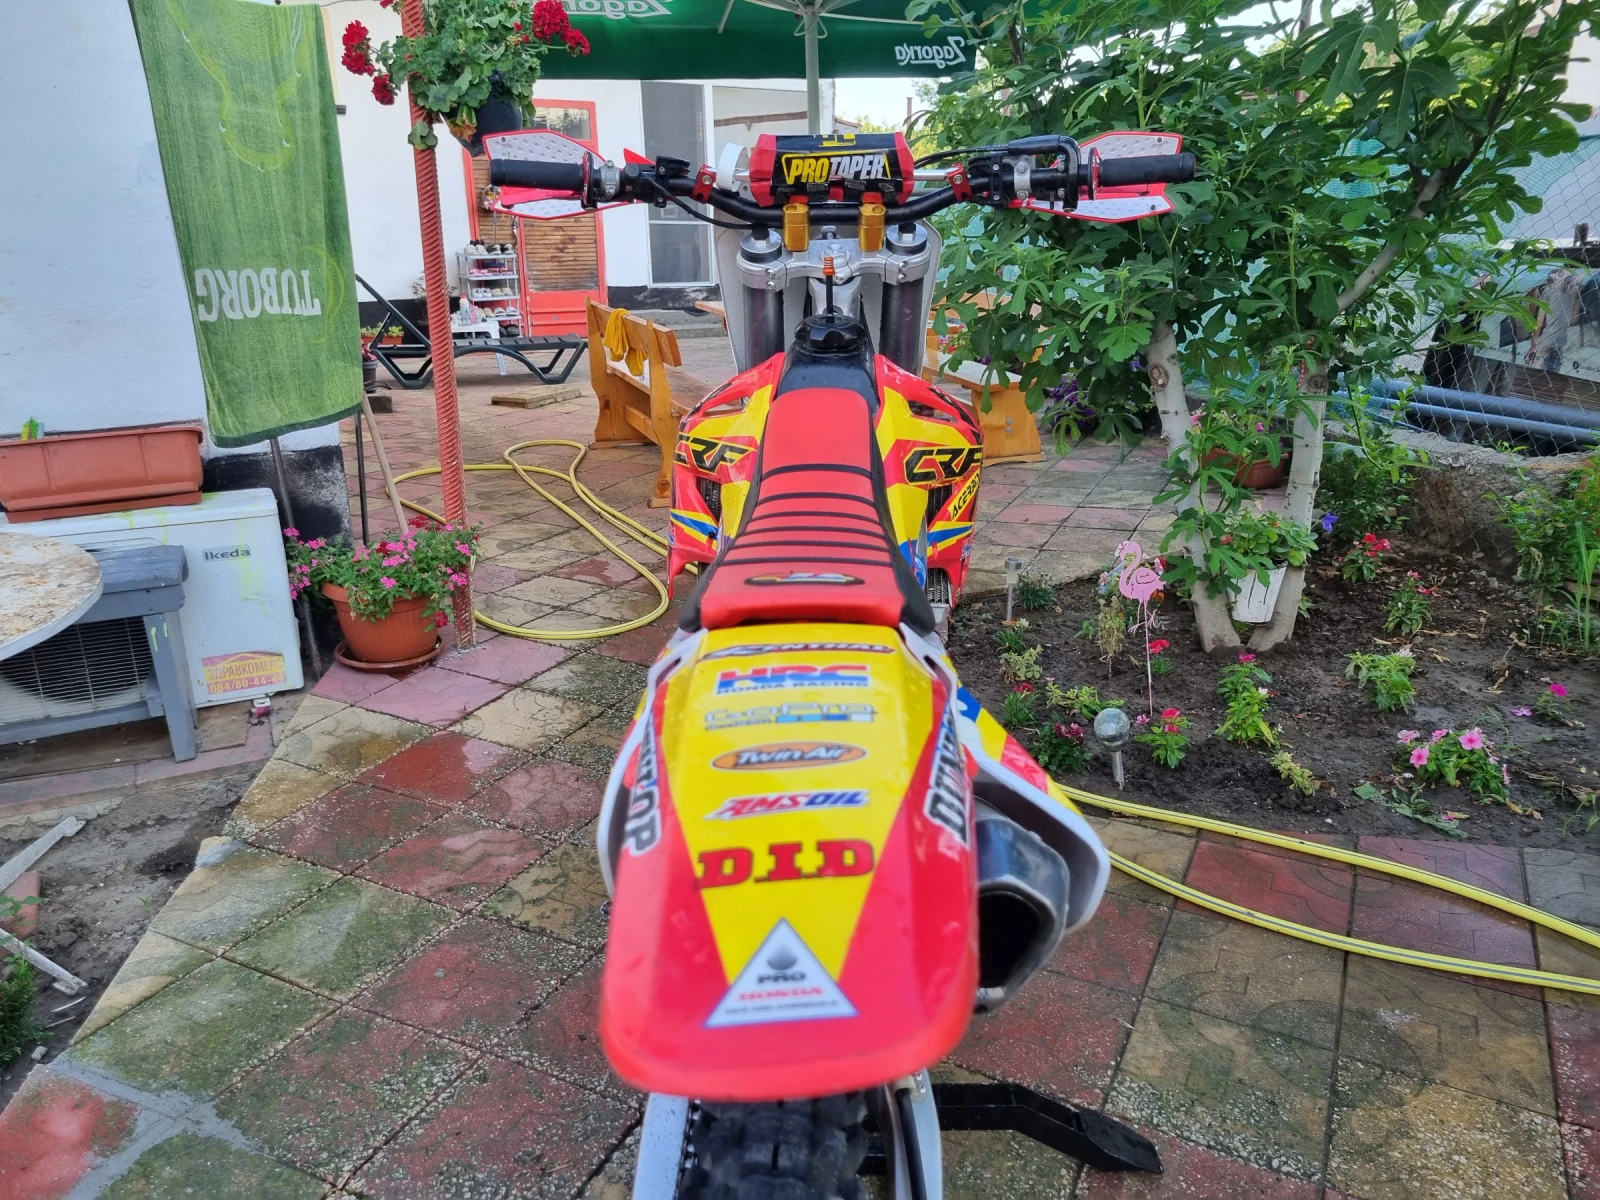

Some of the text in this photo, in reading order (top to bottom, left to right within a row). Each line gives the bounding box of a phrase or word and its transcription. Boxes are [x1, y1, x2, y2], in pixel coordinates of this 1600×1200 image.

[194, 267, 322, 322] TUBORG
[904, 447, 982, 483] CRF
[204, 549, 251, 561] Ikeda
[716, 682, 785, 694] HONDA
[718, 665, 868, 689] HRC
[705, 703, 874, 722] GoPro
[736, 745, 851, 767] Twin Air
[713, 790, 866, 818] AMSOIL
[757, 971, 806, 984] PRO
